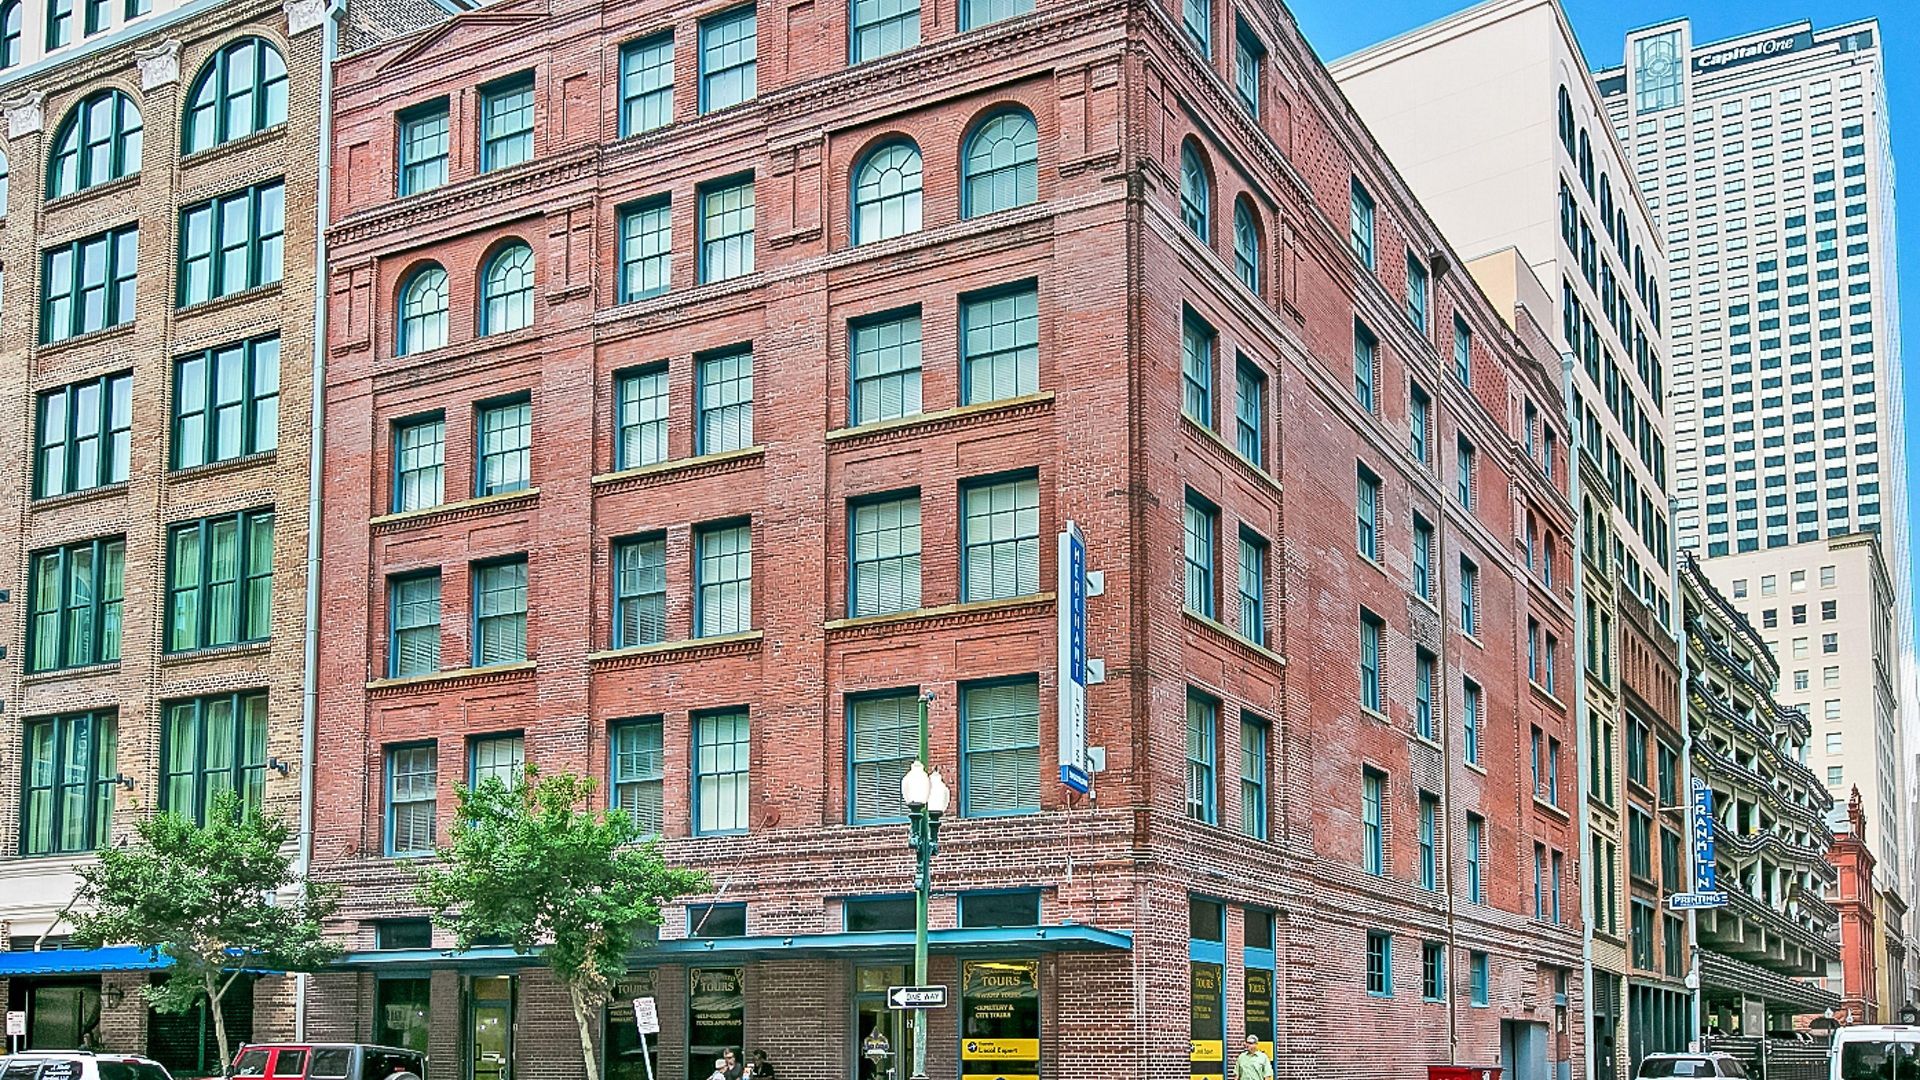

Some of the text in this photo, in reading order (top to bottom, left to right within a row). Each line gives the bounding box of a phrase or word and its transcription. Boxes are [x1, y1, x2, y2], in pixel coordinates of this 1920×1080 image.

[1695, 793, 1710, 888] FRANKLIN
[1674, 894, 1720, 905] PRINTING
[981, 976, 1021, 987] TOURS
[617, 984, 649, 994] TOURS
[700, 982, 735, 992] TOURS
[906, 992, 940, 1001] ONE WAY
